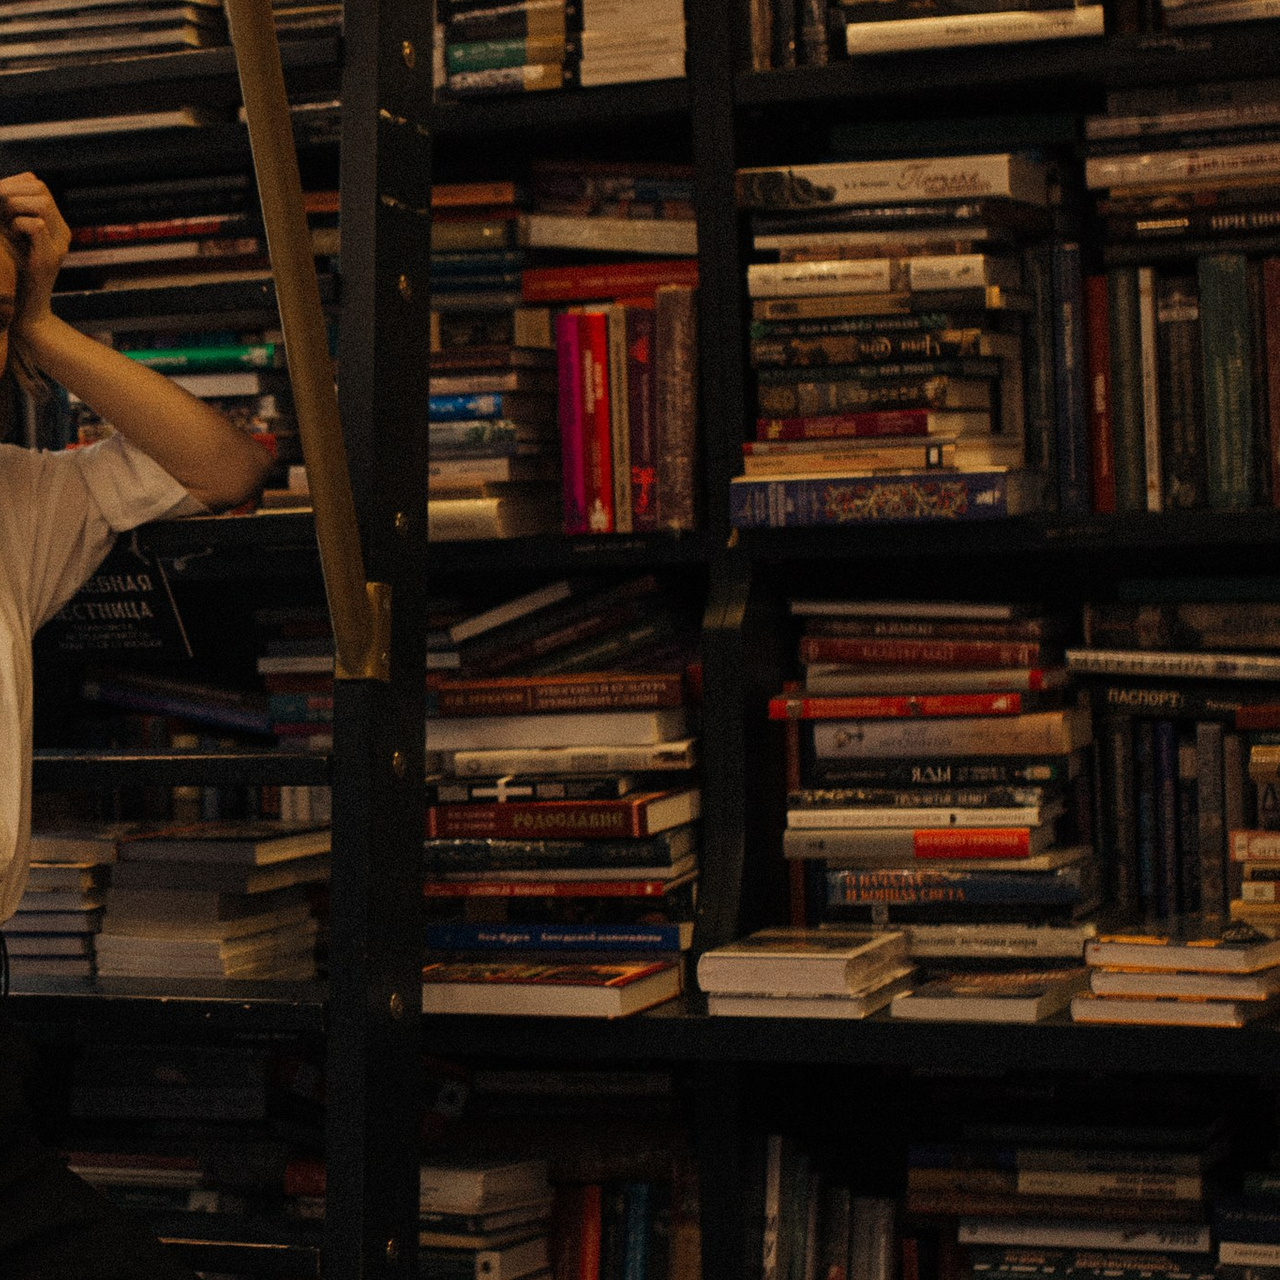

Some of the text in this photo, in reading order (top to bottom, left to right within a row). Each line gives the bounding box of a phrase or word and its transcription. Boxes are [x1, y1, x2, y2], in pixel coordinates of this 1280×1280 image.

[78, 573, 154, 594] ЕБНАЯ
[60, 600, 156, 620] ЕСТНИЦА
[1107, 687, 1180, 708] ПАСПОРТ
